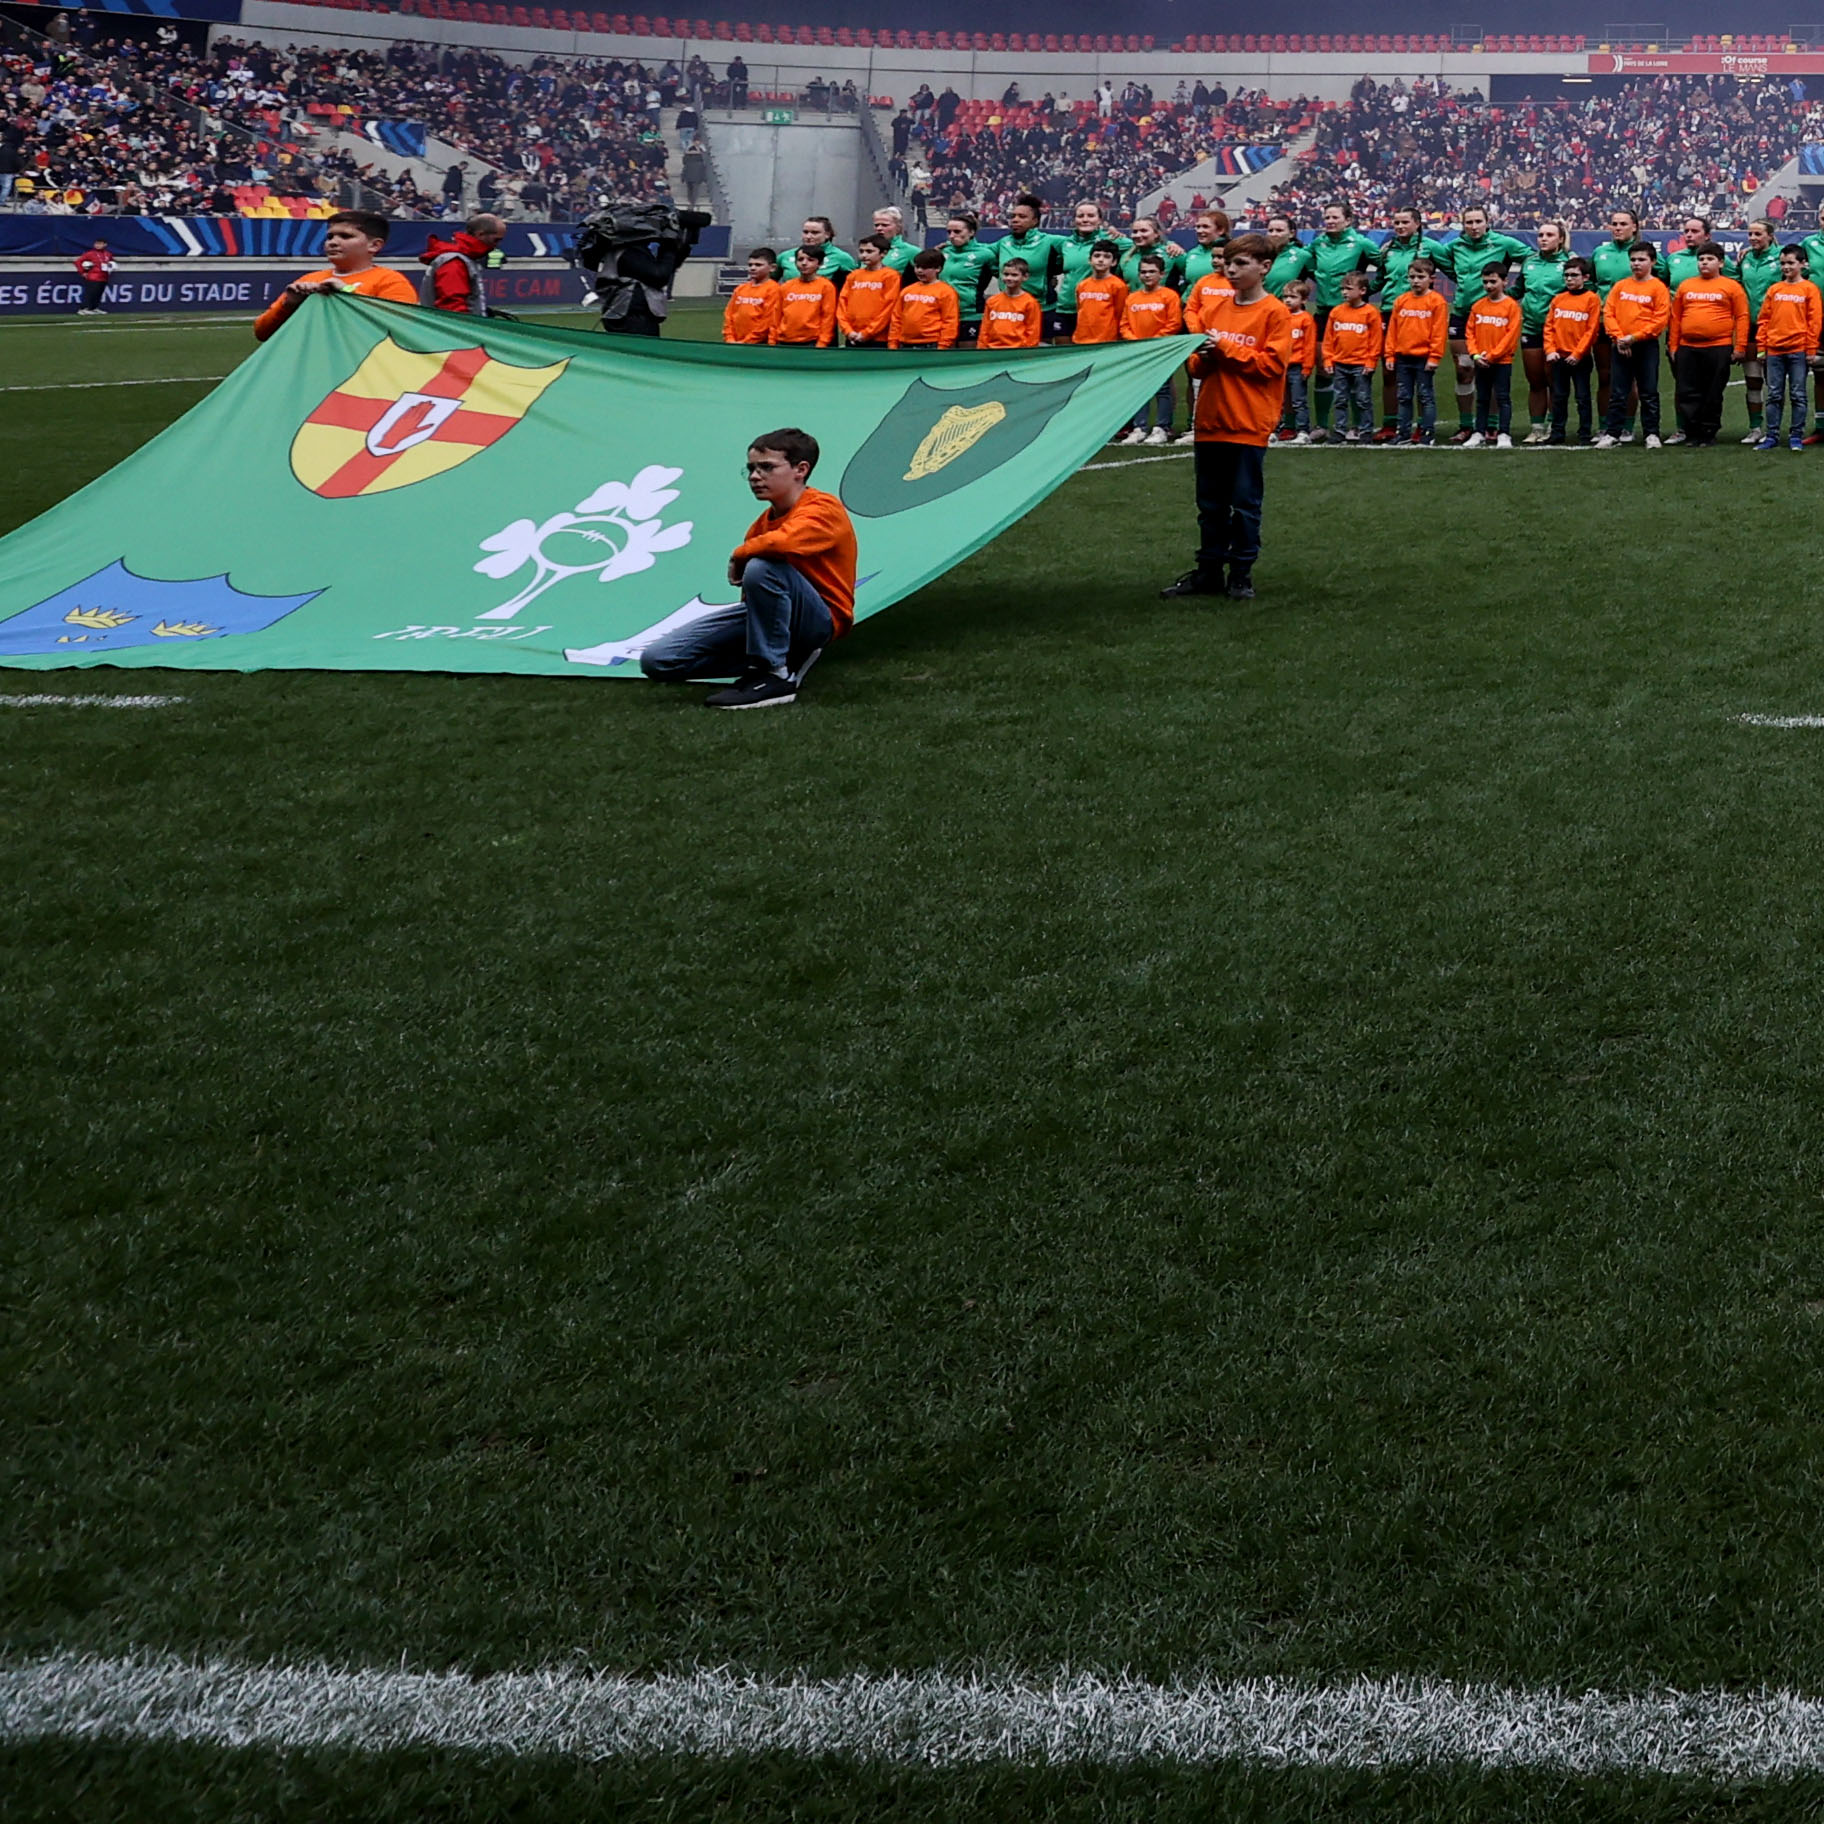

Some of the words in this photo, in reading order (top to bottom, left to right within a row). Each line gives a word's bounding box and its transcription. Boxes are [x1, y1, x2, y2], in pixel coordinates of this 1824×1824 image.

[1738, 56, 1768, 64] course
[515, 278, 561, 298] CAM
[36, 281, 133, 305] ÉCRNS
[140, 284, 173, 303] DU
[180, 283, 250, 302] STADE
[263, 283, 271, 301] !
[787, 293, 821, 301] Orange
[1686, 292, 1722, 301] Orange
